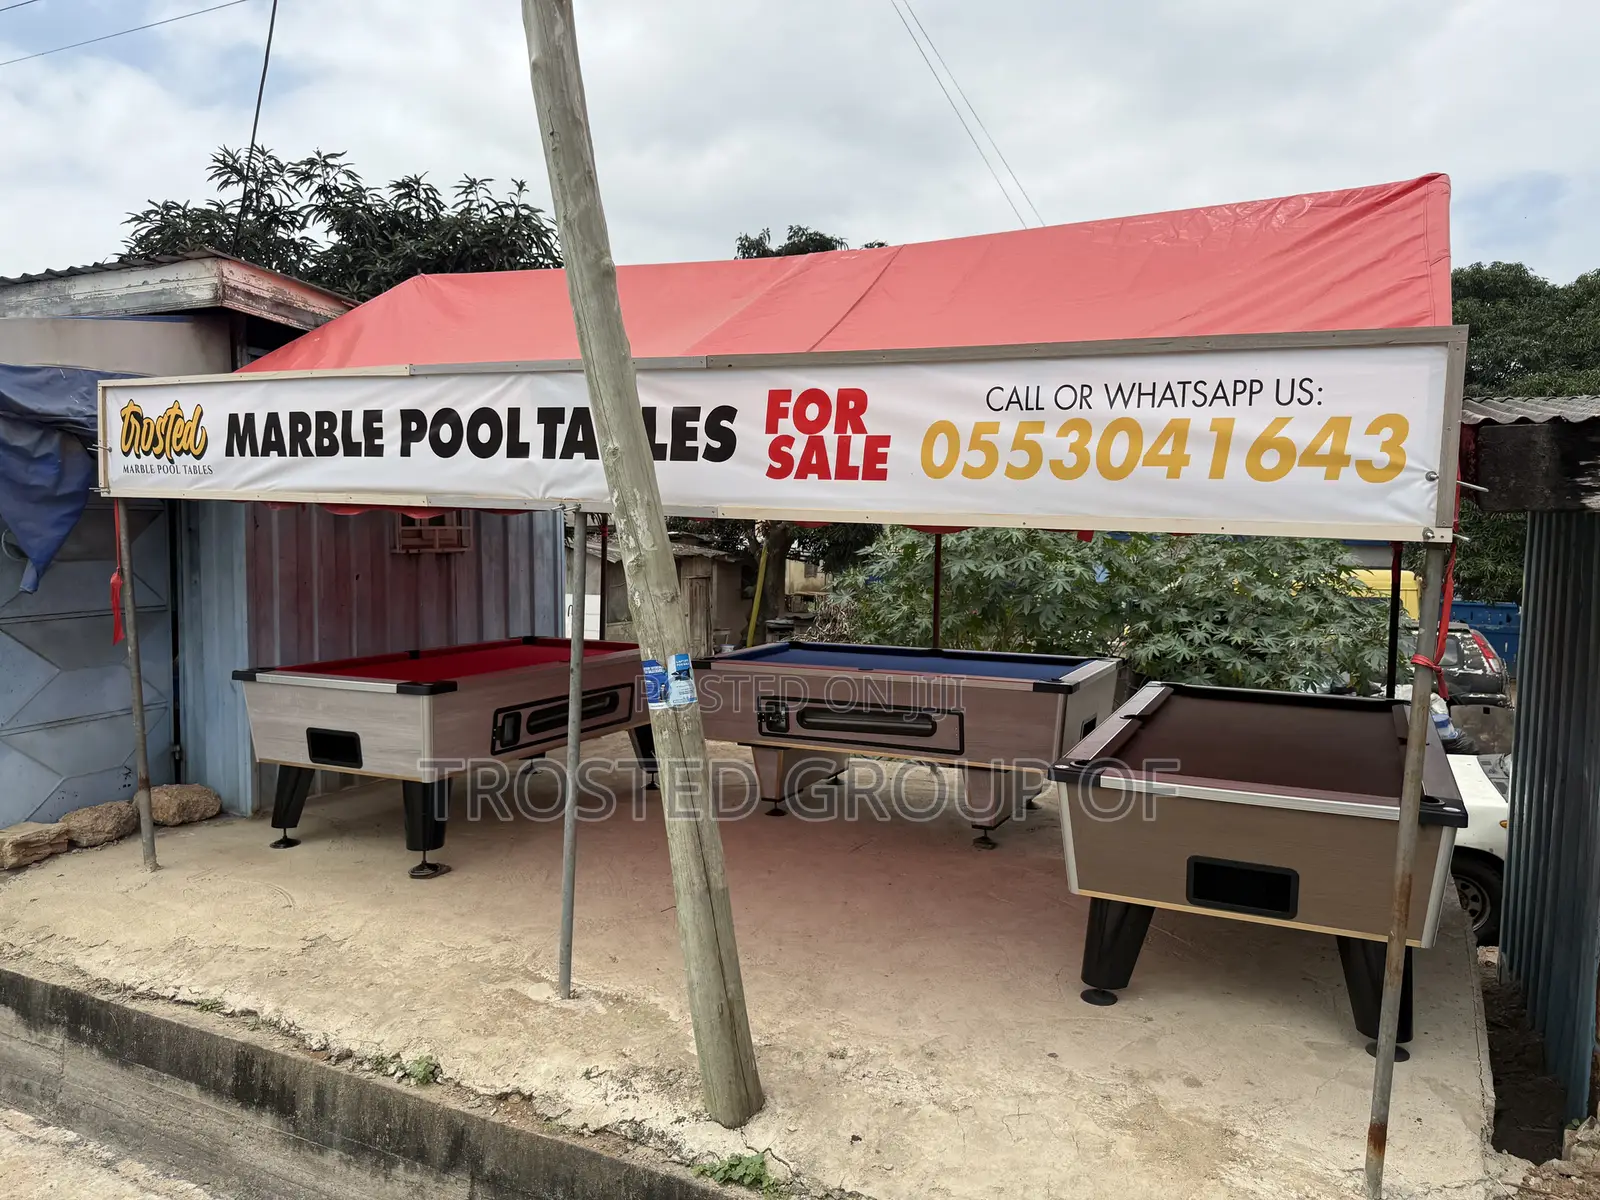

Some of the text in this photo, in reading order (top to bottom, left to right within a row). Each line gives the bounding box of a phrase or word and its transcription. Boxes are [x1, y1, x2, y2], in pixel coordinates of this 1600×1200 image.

[765, 387, 869, 435] FOR
[986, 377, 1324, 412] CALL OR WHATSAPP US:
[225, 405, 738, 463] MARBLE POOL TALES
[765, 434, 892, 481] SALE
[920, 412, 1411, 484] 0553041643
[122, 464, 213, 475] MARBLE POOL TABLES
